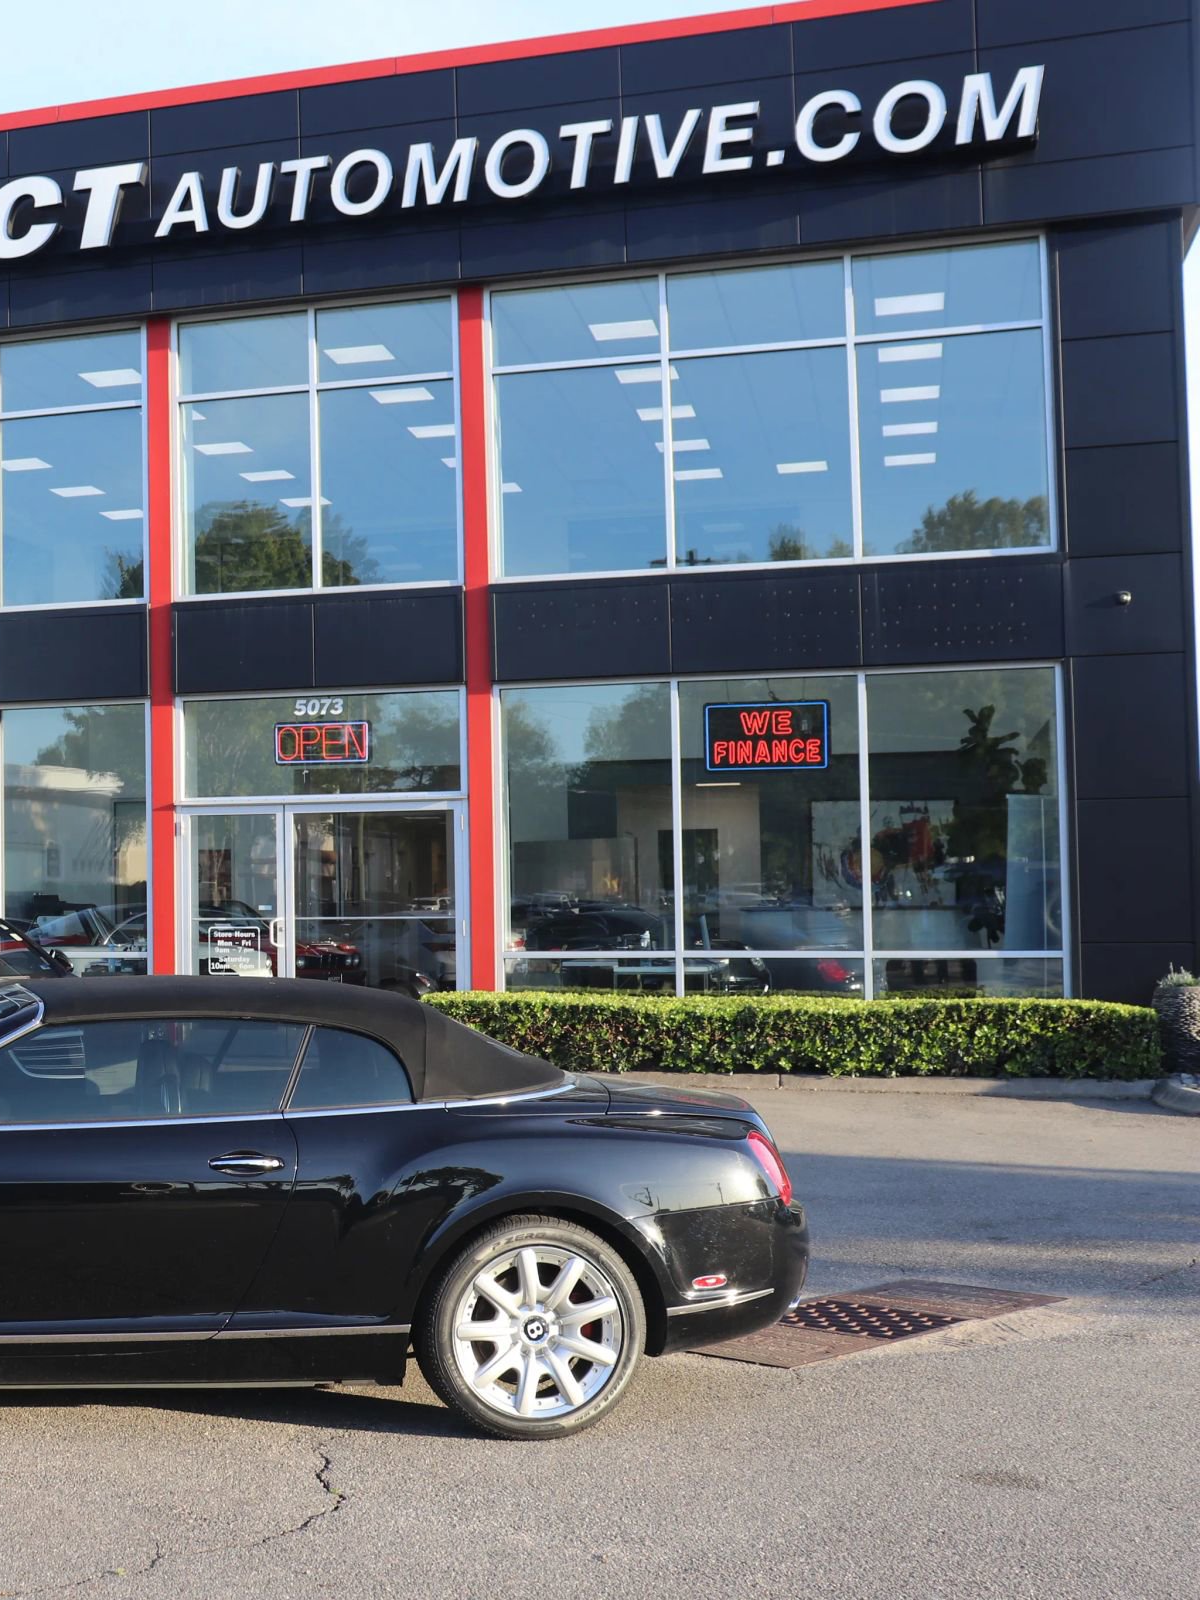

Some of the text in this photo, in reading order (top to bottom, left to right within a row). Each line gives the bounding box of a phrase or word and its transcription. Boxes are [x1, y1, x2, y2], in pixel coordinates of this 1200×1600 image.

[155, 65, 1046, 237] AUTOMOTIVE.COM
[293, 697, 344, 716] 5073
[740, 710, 793, 736] WE
[278, 723, 368, 761] OPEN
[714, 738, 821, 764] FINANCE
